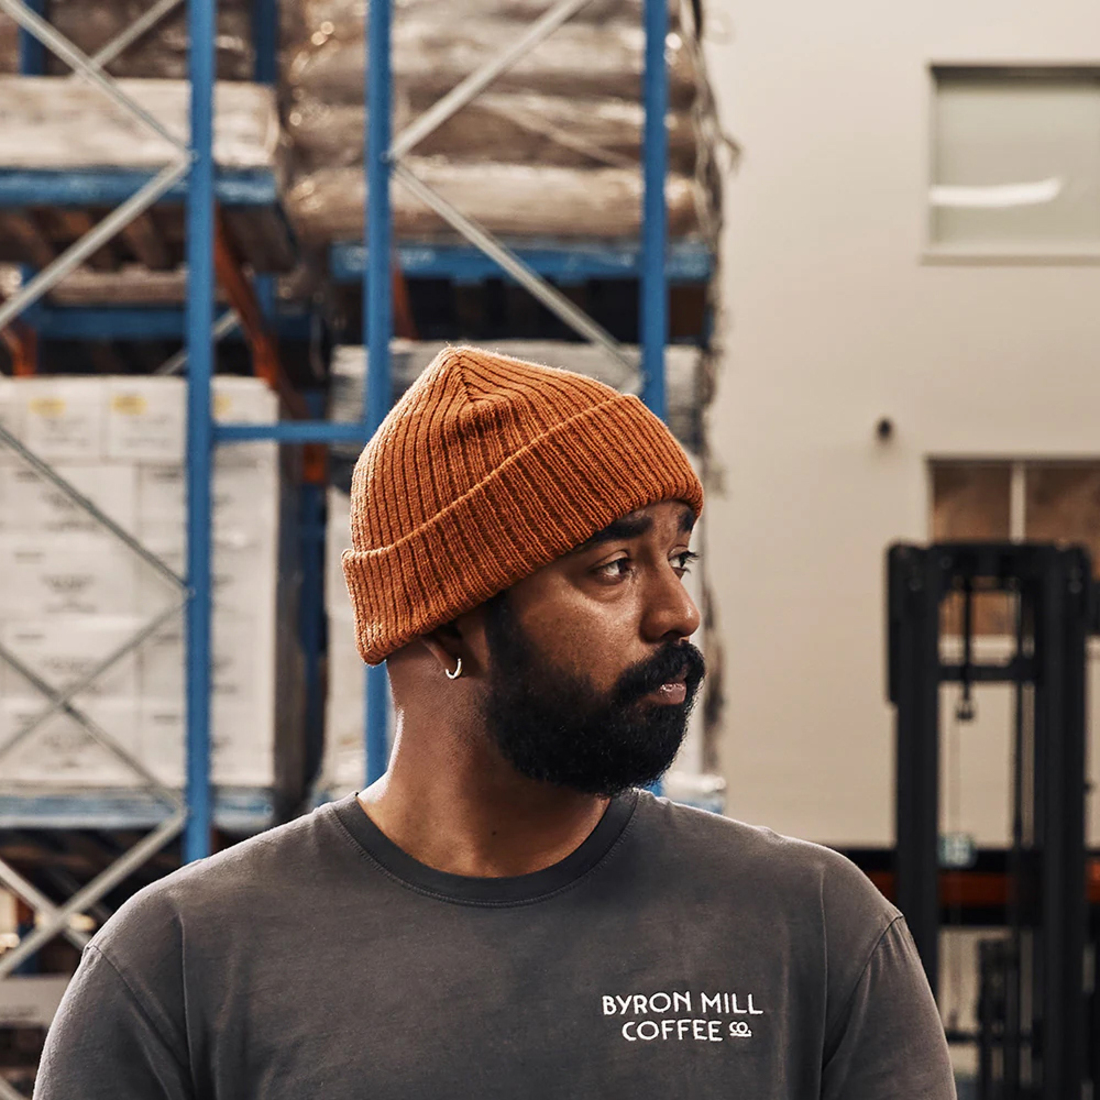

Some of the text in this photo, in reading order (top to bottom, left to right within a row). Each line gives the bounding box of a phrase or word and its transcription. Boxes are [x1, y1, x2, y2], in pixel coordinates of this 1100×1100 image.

[601, 991, 764, 1015] BYRON MILL
[621, 1019, 723, 1041] COFFEE
